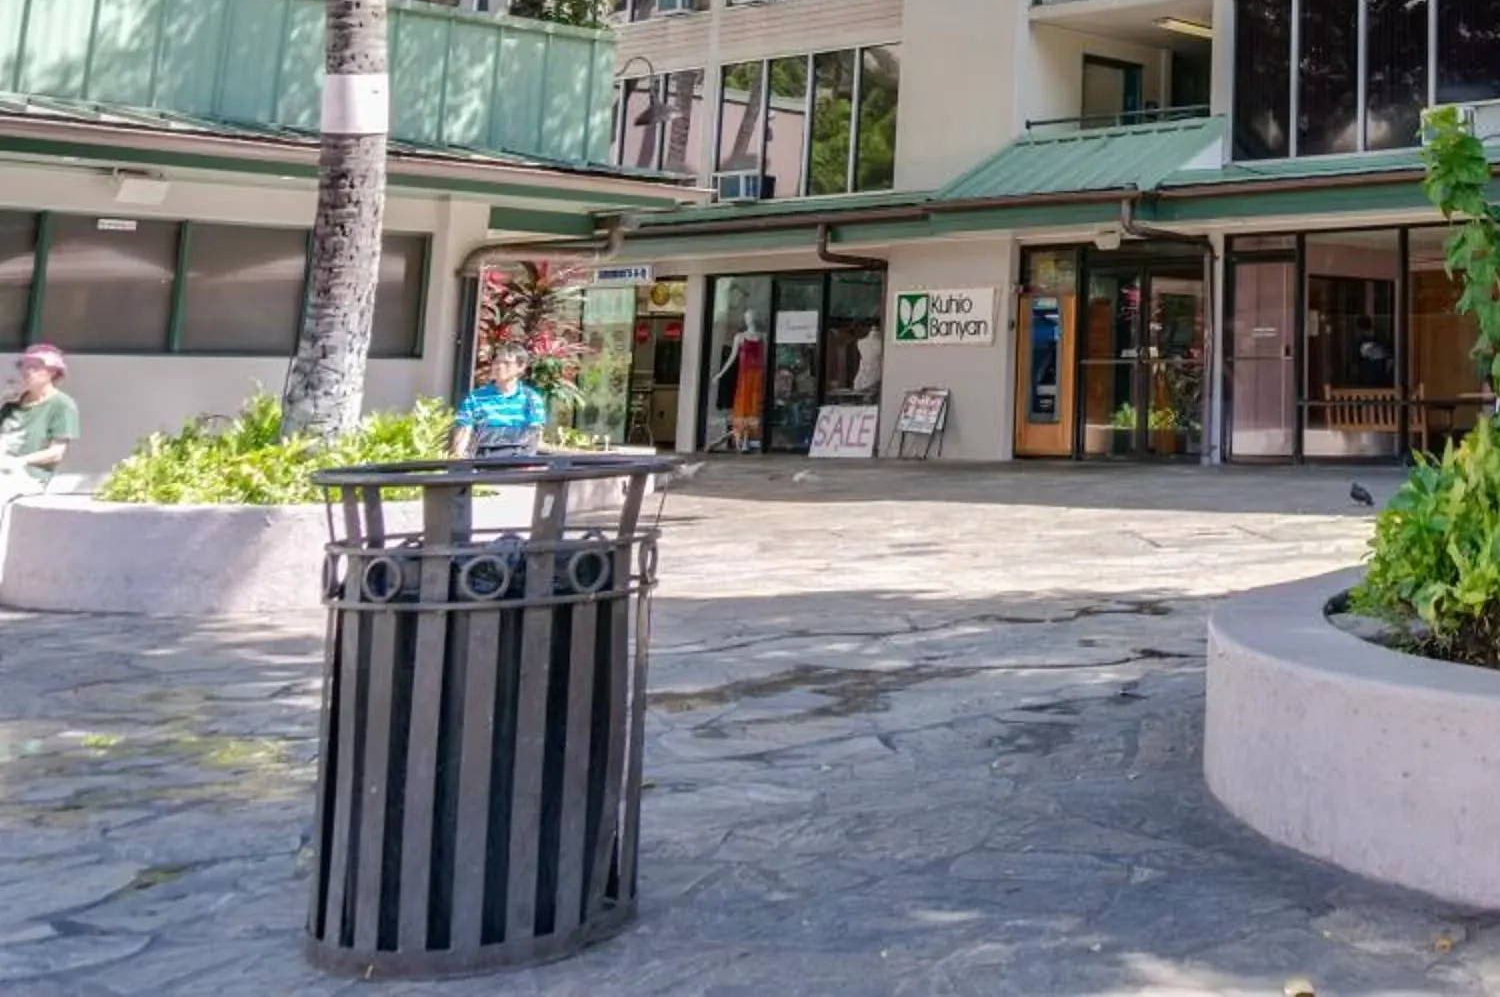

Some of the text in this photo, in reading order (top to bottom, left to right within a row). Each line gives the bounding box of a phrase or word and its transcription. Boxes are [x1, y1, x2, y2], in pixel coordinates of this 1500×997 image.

[930, 294, 973, 314] Kuhio
[929, 317, 989, 341] Banyan
[813, 413, 876, 448] SALE
